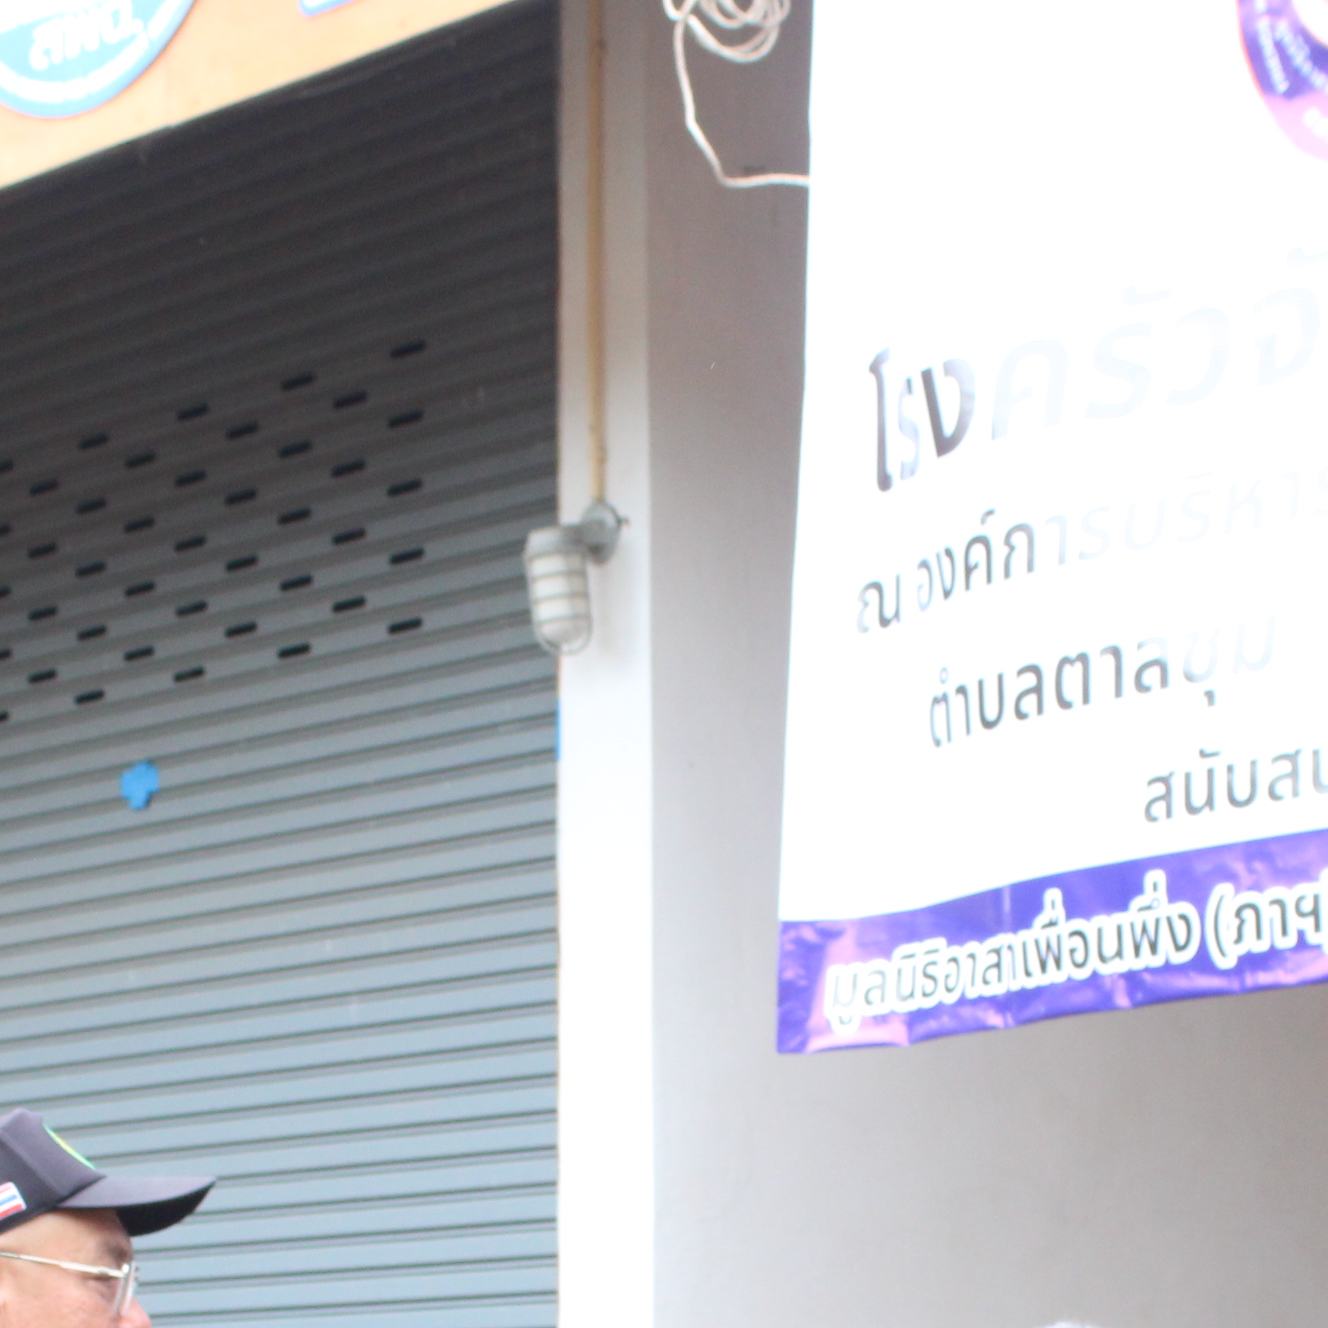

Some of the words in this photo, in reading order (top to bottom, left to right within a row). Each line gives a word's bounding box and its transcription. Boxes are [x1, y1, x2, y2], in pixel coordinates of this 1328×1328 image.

[854, 570, 906, 636] ณ
[926, 615, 1278, 752] ตำบลตาลชุม
[828, 880, 1199, 1025] มูลนิธิอาสาเพื่อนพึ่ง
